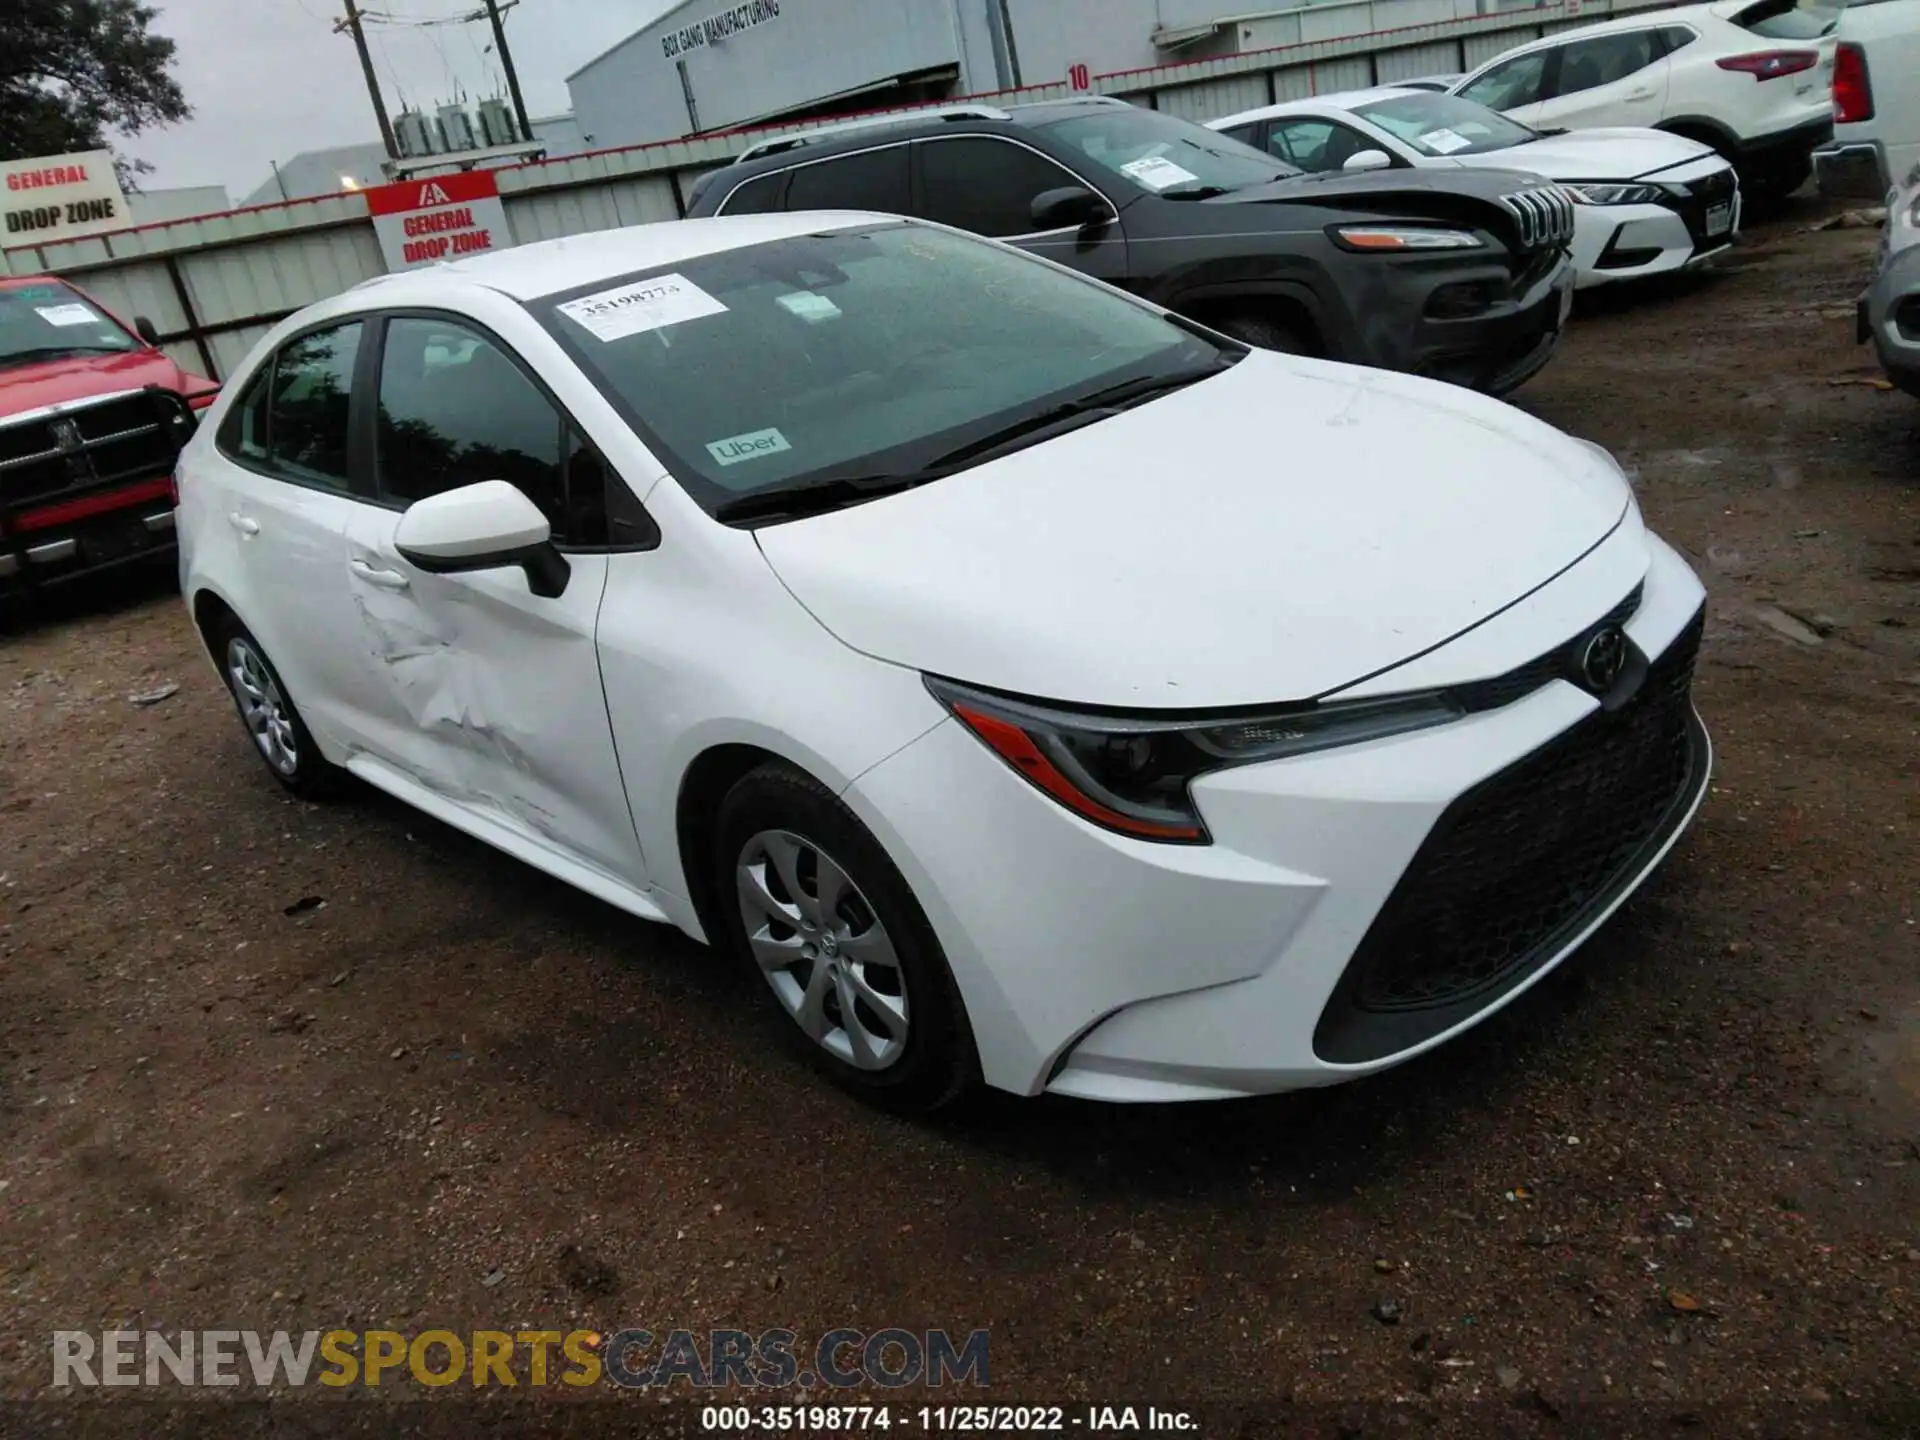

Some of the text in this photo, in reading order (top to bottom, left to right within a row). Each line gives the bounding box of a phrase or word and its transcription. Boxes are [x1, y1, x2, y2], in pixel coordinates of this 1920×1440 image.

[661, 0, 780, 58] BOX GANG MANUFACTURING
[1069, 63, 1089, 91] 10
[7, 165, 89, 191] GENERAL
[5, 198, 115, 233] DROP ZONE
[403, 207, 476, 237] GENERAL
[403, 229, 492, 263] DROP ZONE
[716, 435, 777, 458] Uber
